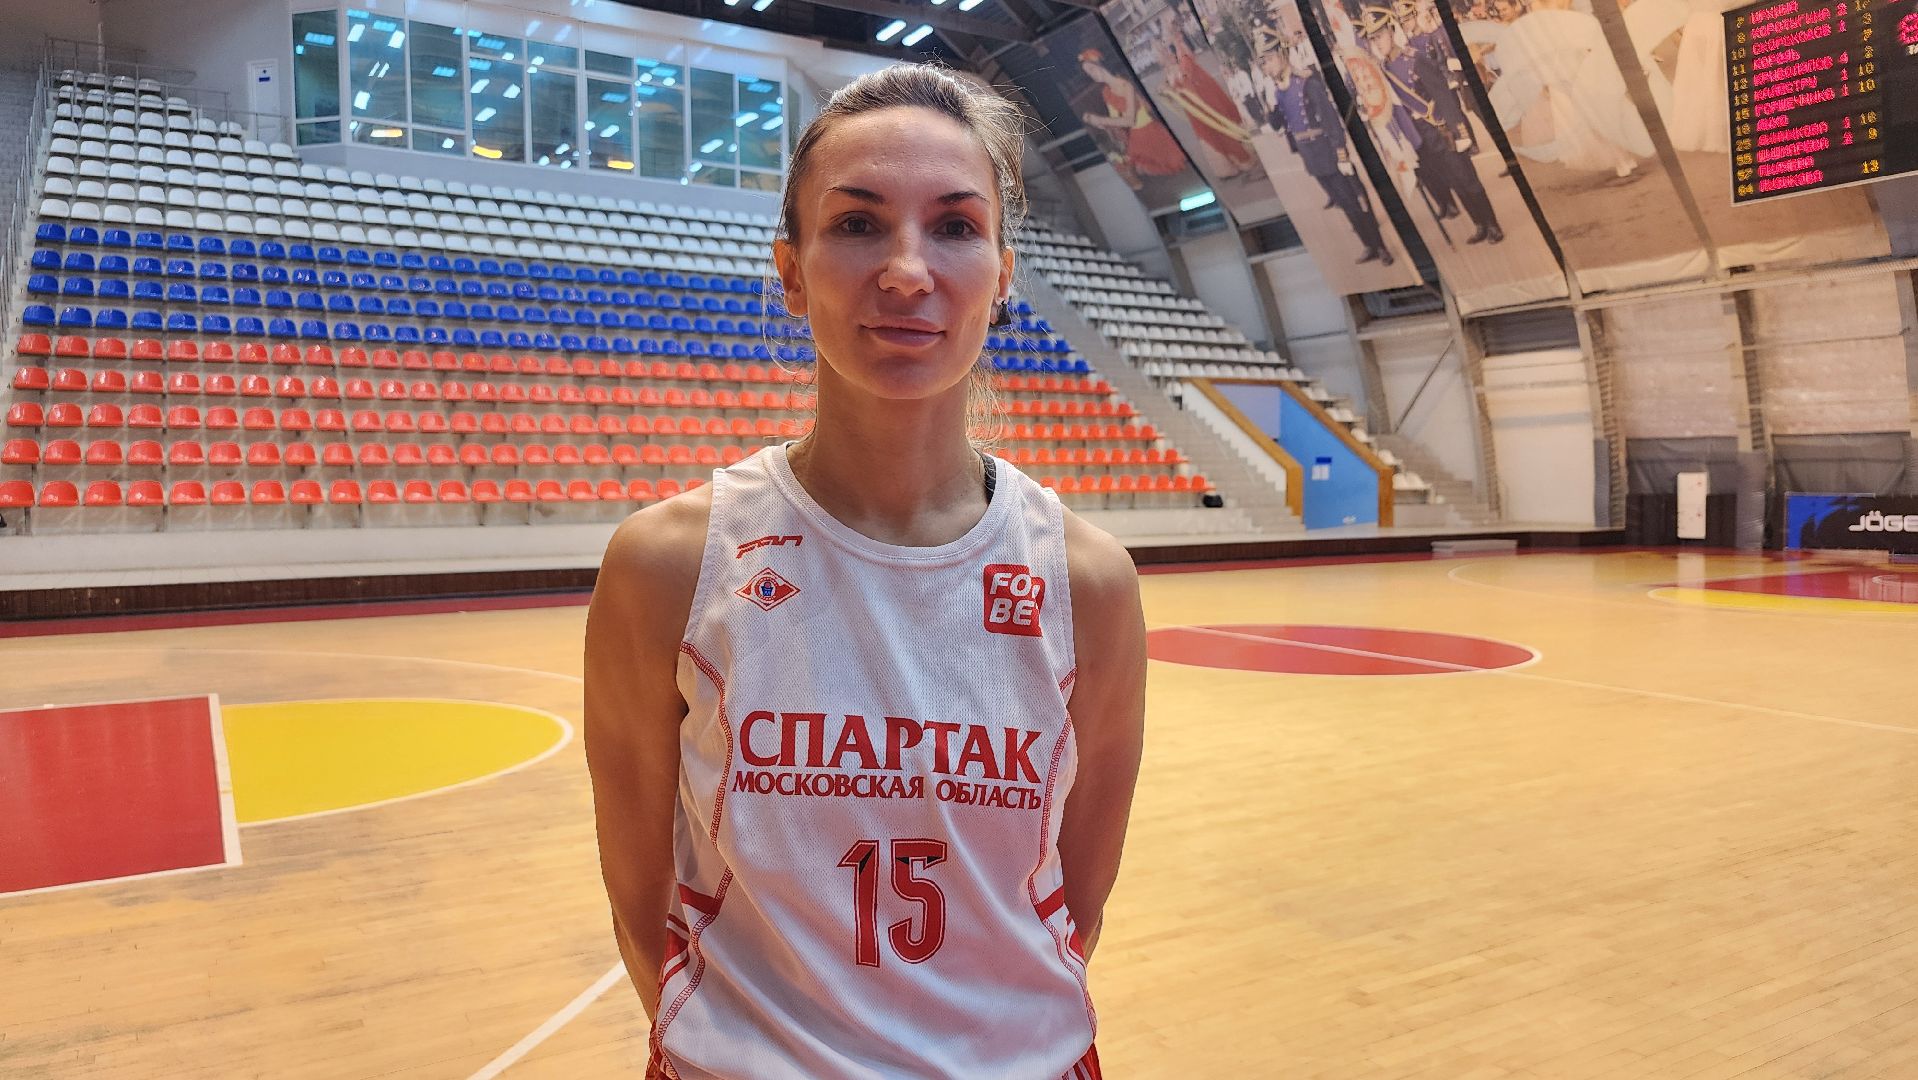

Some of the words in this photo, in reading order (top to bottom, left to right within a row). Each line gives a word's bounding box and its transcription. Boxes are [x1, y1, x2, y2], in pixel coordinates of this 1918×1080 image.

[739, 709, 1043, 785] СПАРТАК
[732, 770, 925, 800] МОСКОВСКАЯ
[936, 779, 1043, 812] ОБЛАСТЬ
[837, 838, 949, 968] 15
